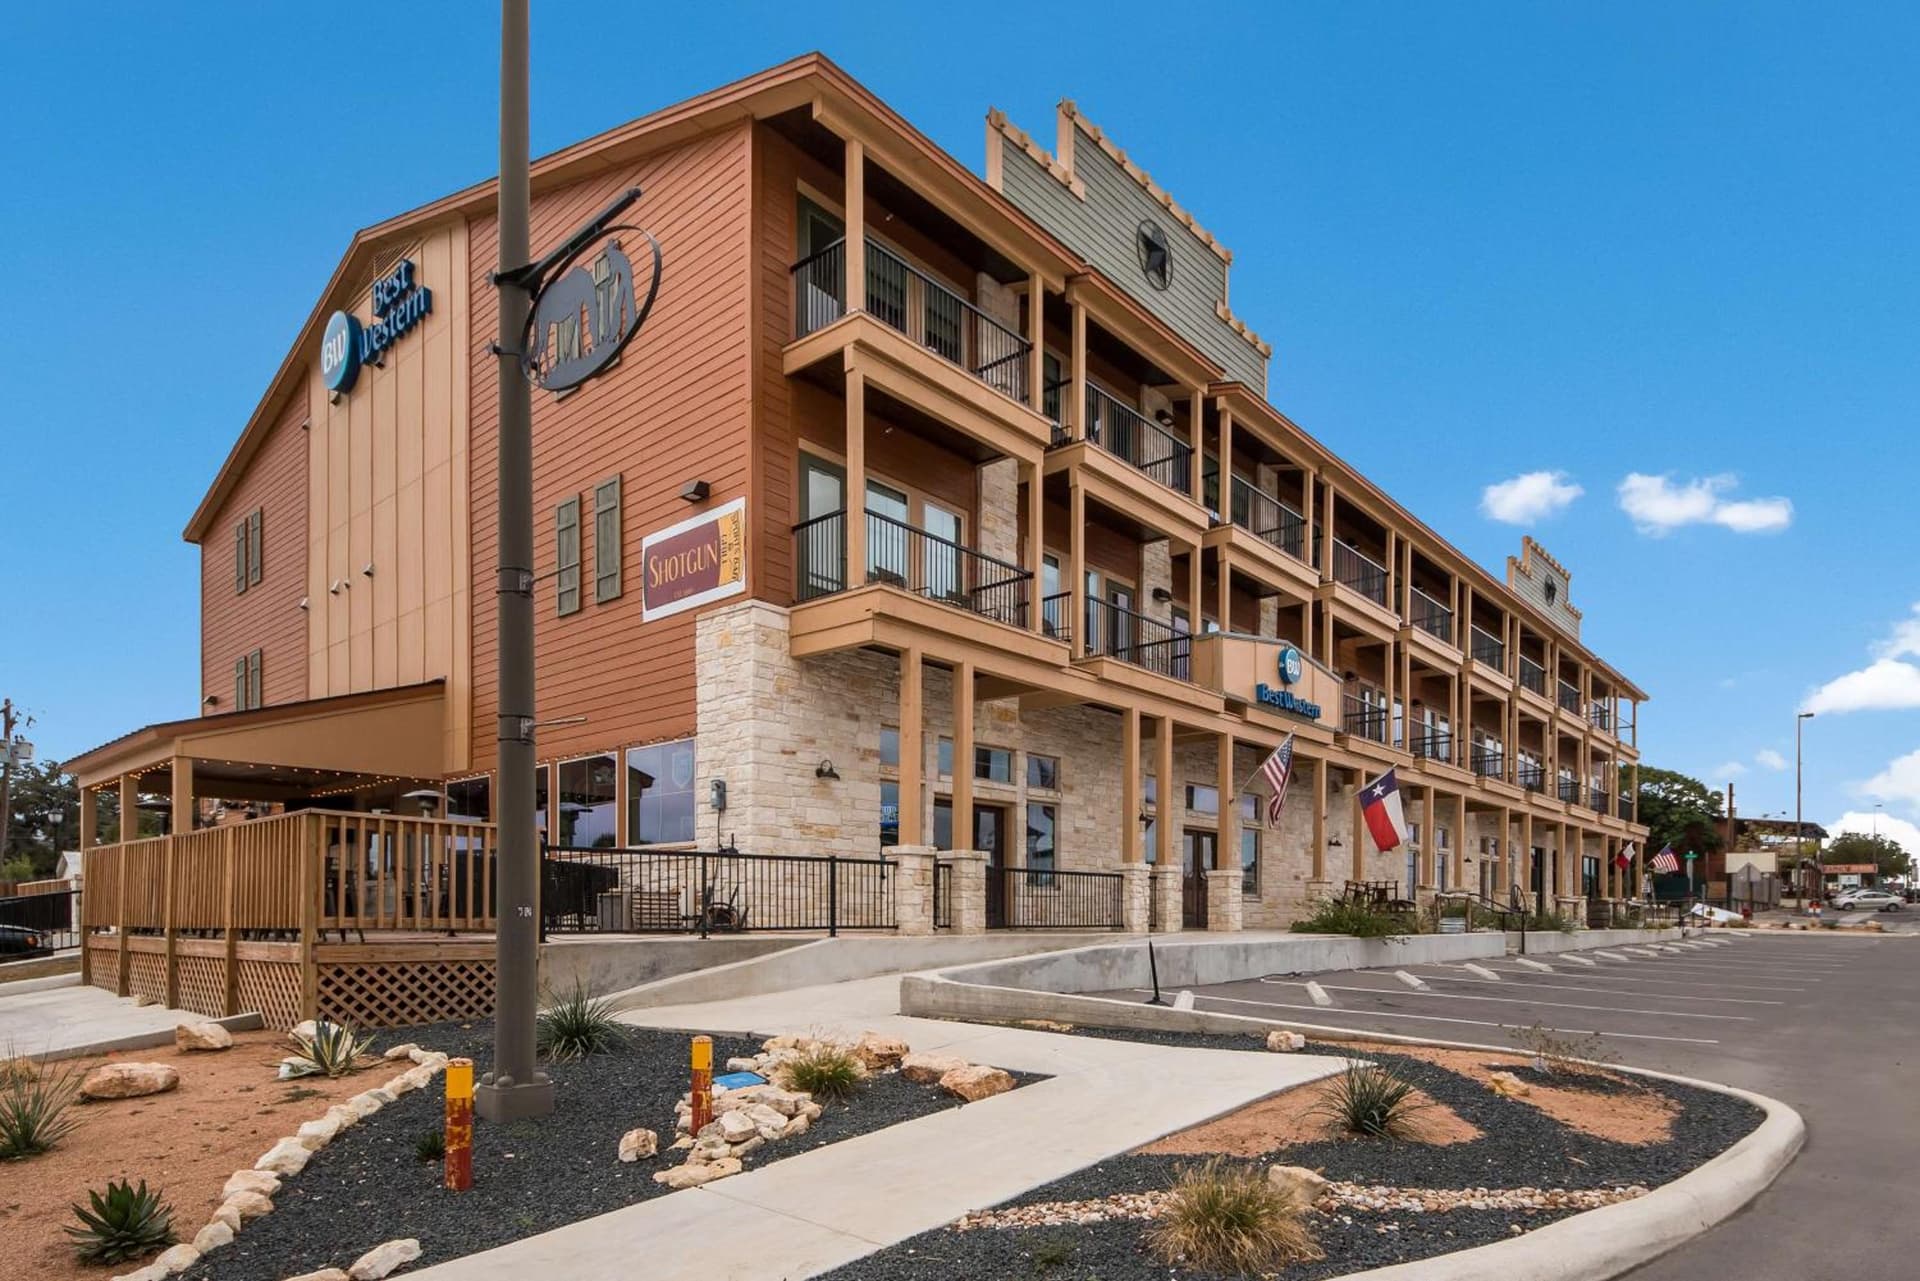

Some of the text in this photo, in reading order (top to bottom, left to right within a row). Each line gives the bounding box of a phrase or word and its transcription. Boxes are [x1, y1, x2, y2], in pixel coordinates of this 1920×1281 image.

[372, 259, 413, 316] Best
[359, 286, 431, 365] Western
[649, 540, 718, 588] SHOTGUN
